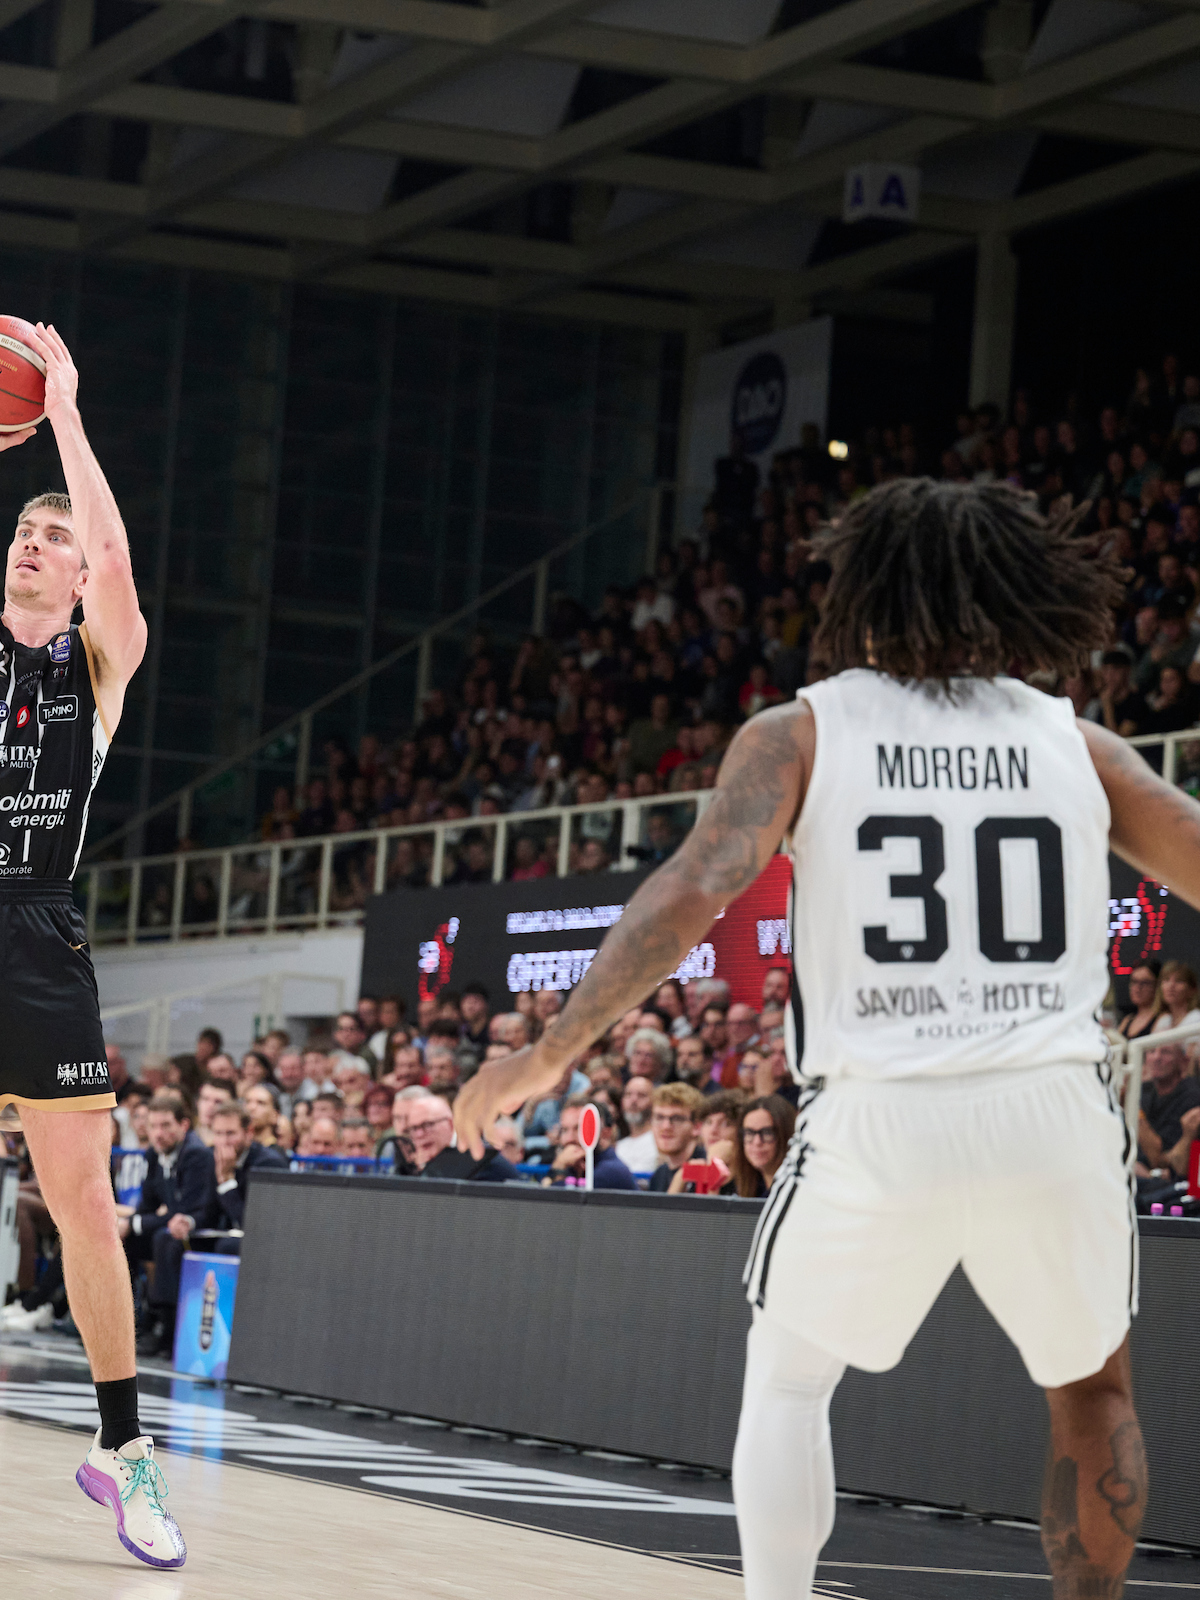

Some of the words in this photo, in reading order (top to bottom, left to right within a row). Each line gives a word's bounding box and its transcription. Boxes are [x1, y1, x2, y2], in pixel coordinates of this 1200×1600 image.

[10, 761, 32, 769] MUTU
[877, 744, 1029, 790] MORGAN
[857, 815, 1067, 963] 30
